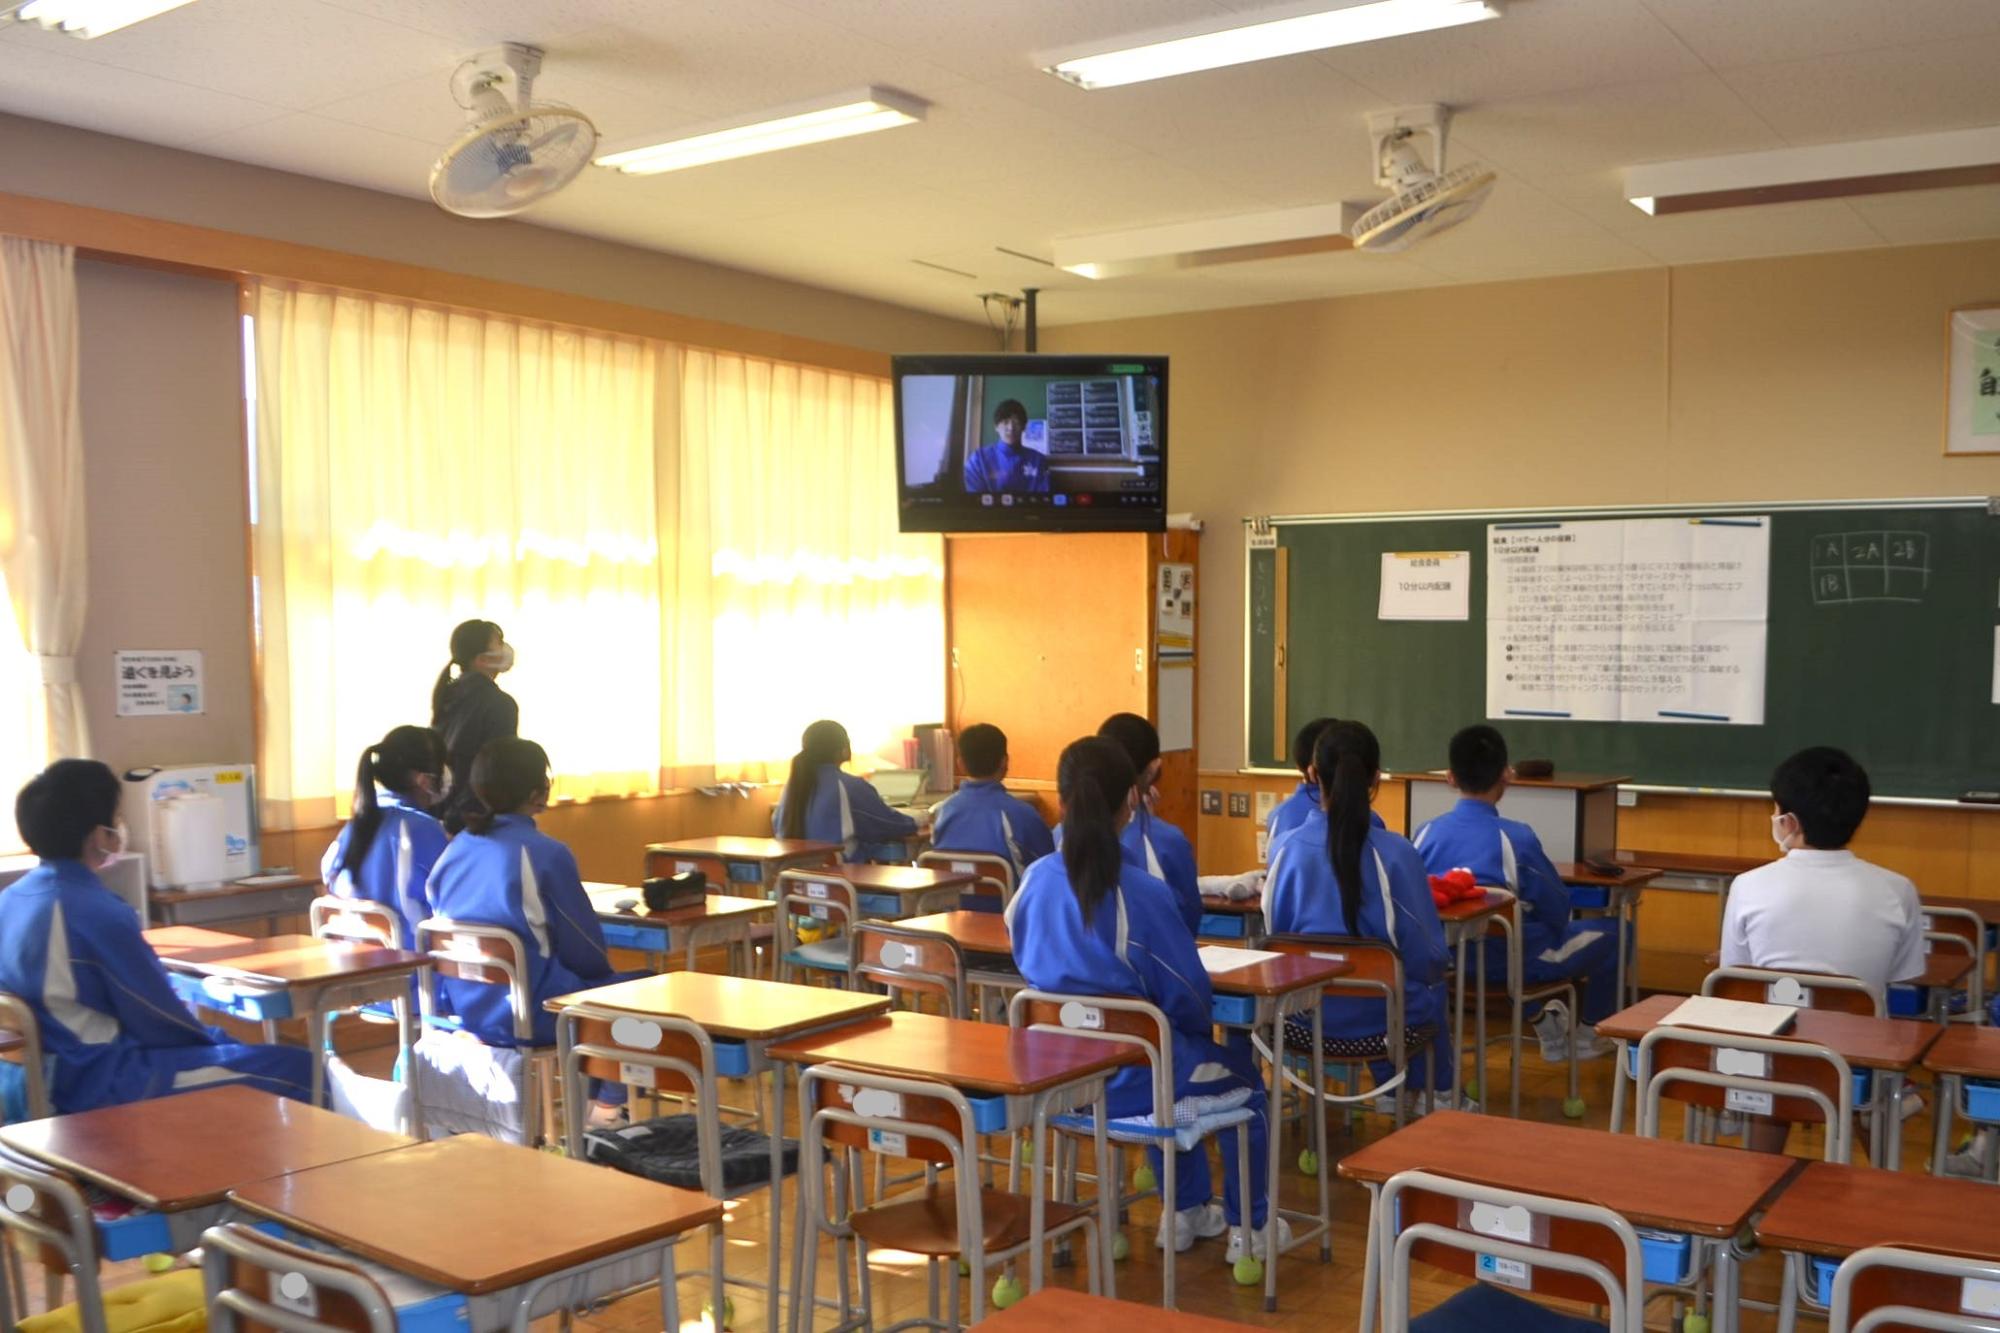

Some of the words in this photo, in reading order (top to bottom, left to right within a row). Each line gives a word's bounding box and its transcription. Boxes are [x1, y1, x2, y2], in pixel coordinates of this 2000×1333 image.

[1850, 542, 1880, 559] 2A
[1819, 574, 1840, 596] 1B
[122, 665, 194, 679] 遠くを見よう
[1482, 1255, 1492, 1269] 2
